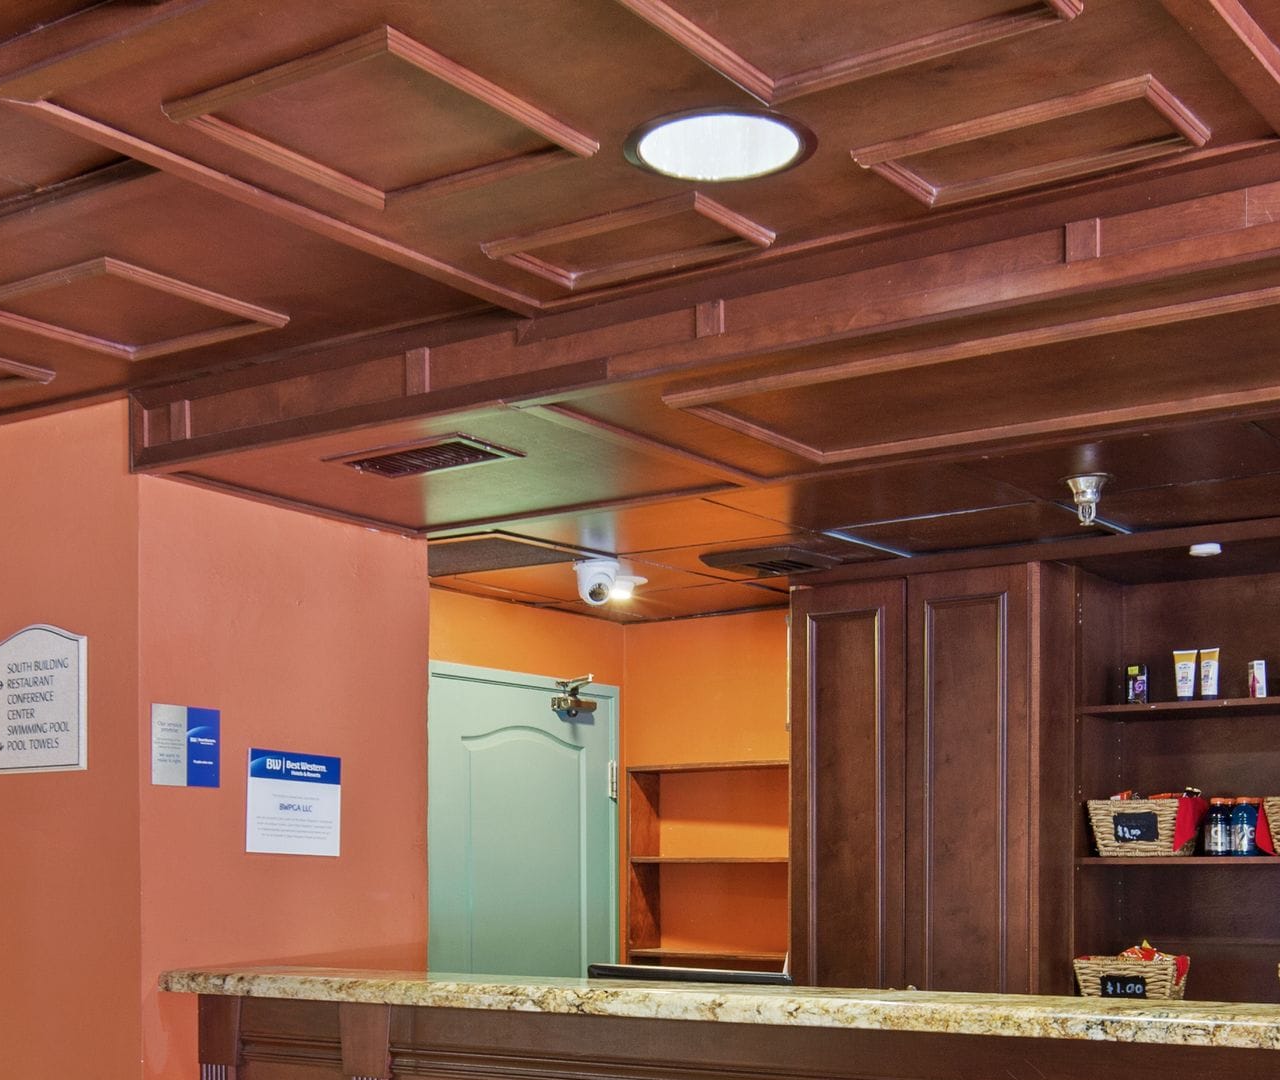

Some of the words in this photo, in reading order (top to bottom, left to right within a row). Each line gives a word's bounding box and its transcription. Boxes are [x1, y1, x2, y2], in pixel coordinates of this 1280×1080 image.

[7, 661, 32, 674] SOUTH
[34, 658, 69, 671] BUILDING
[7, 675, 54, 690] RESTAURANT
[7, 691, 54, 705] CONFERENCE
[7, 708, 35, 721] CENTER
[7, 722, 48, 736] SWIMMING
[49, 721, 70, 733] POOL
[7, 740, 26, 751] POOL
[30, 737, 59, 749] TOWELS
[266, 758, 282, 771] BW
[286, 760, 300, 770] Best
[1106, 981, 1143, 994] $1.00
